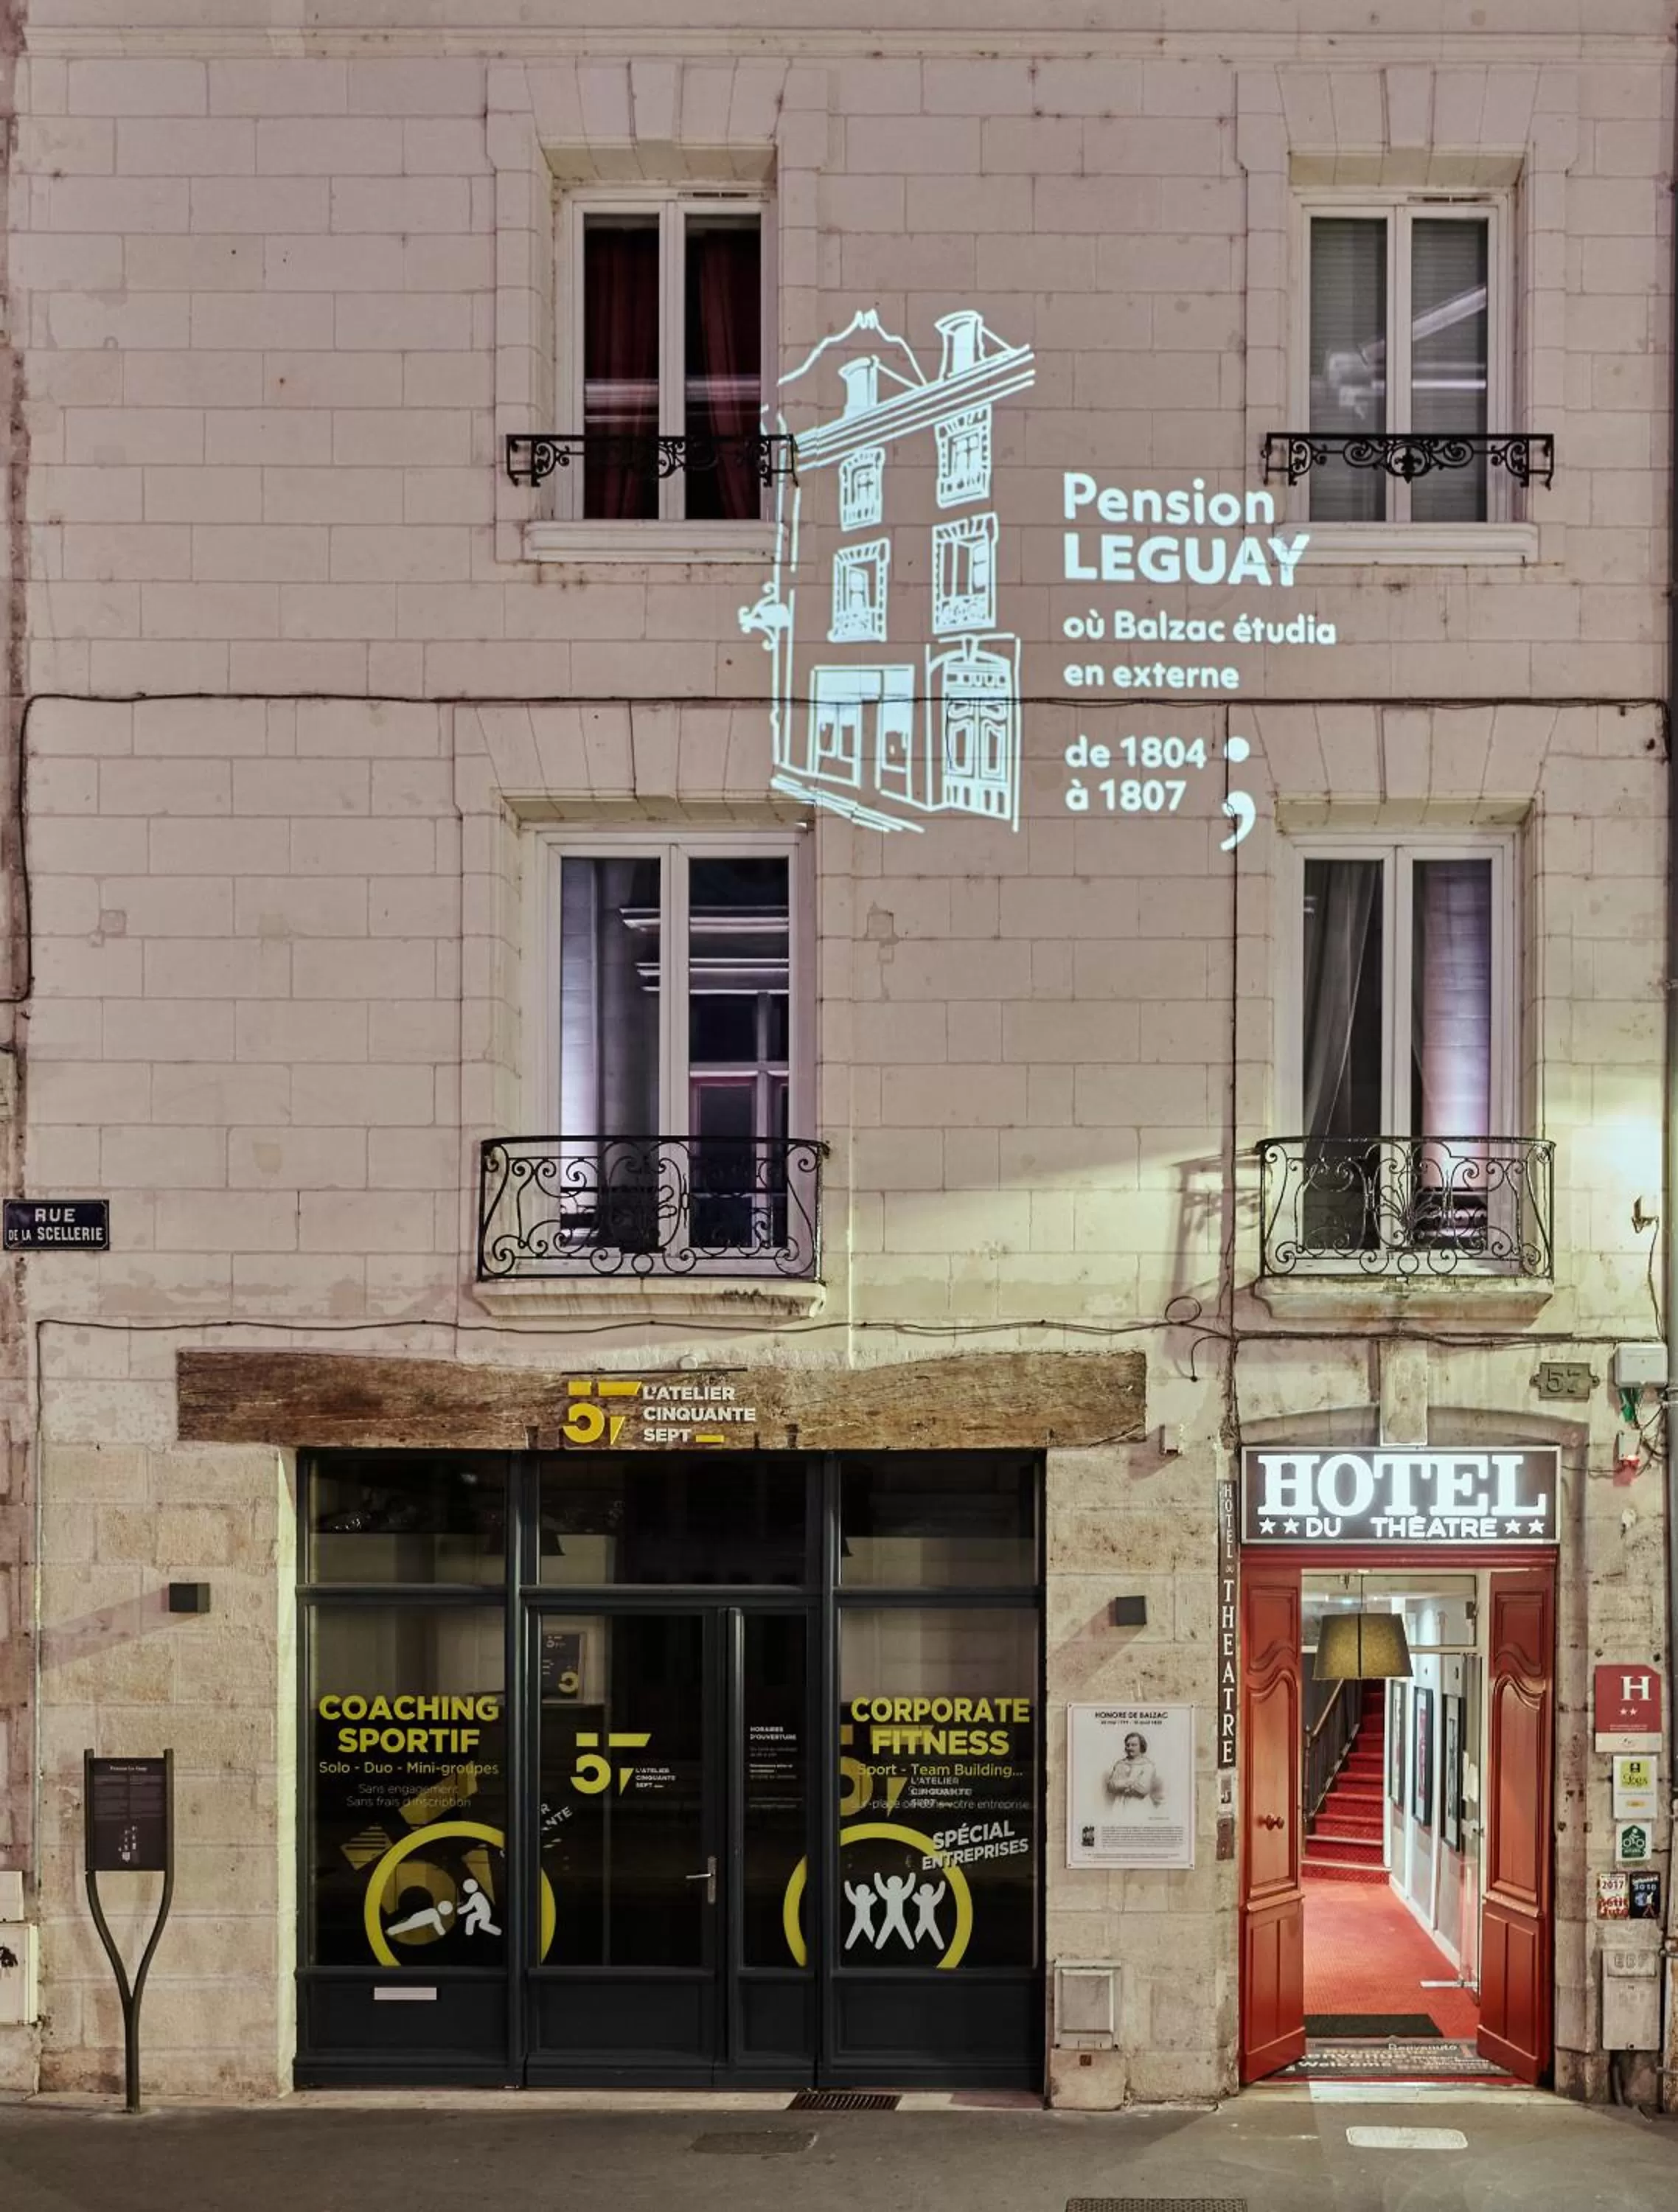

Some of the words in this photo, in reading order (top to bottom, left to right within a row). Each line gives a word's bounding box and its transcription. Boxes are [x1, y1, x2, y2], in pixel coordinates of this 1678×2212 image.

[1063, 472, 1274, 526] Pension
[1063, 532, 1310, 587] LEGUAY
[1062, 609, 1105, 639] où
[1114, 609, 1225, 642] Balzac
[1233, 613, 1336, 645] étudia
[1063, 663, 1104, 686] en
[1112, 662, 1239, 689] externe
[1065, 734, 1110, 768] de
[1120, 736, 1207, 768] 1804
[1065, 779, 1089, 811] à
[1099, 779, 1186, 812] 1807
[35, 1208, 75, 1222] RUE
[8, 1229, 18, 1241] DE
[21, 1229, 32, 1241] LA
[38, 1226, 104, 1241] SCELLERIE
[642, 1386, 735, 1400] L'ATELIER
[643, 1407, 756, 1422] CINQUANTE
[644, 1428, 692, 1442] SEPT
[1258, 1453, 1547, 1516] HOTEL
[1222, 1484, 1234, 1558] HOTEL
[1305, 1517, 1341, 1538] DU
[1222, 1579, 1235, 1763] THEATRE
[1620, 1676, 1651, 1701] H
[318, 1694, 500, 1721] COACHING
[852, 1697, 1030, 1722] CORPORATE
[338, 1728, 480, 1753] SPORTIF
[872, 1730, 1010, 1756] FITNESS
[319, 1761, 350, 1774] Solo
[364, 1761, 393, 1774] Duo
[407, 1761, 499, 1777] Mini-groupes
[857, 1763, 896, 1778] Sport
[911, 1763, 950, 1775] Team
[932, 1820, 1015, 1851] SPÉCIAL
[922, 1838, 1029, 1871] ENTREPRISES
